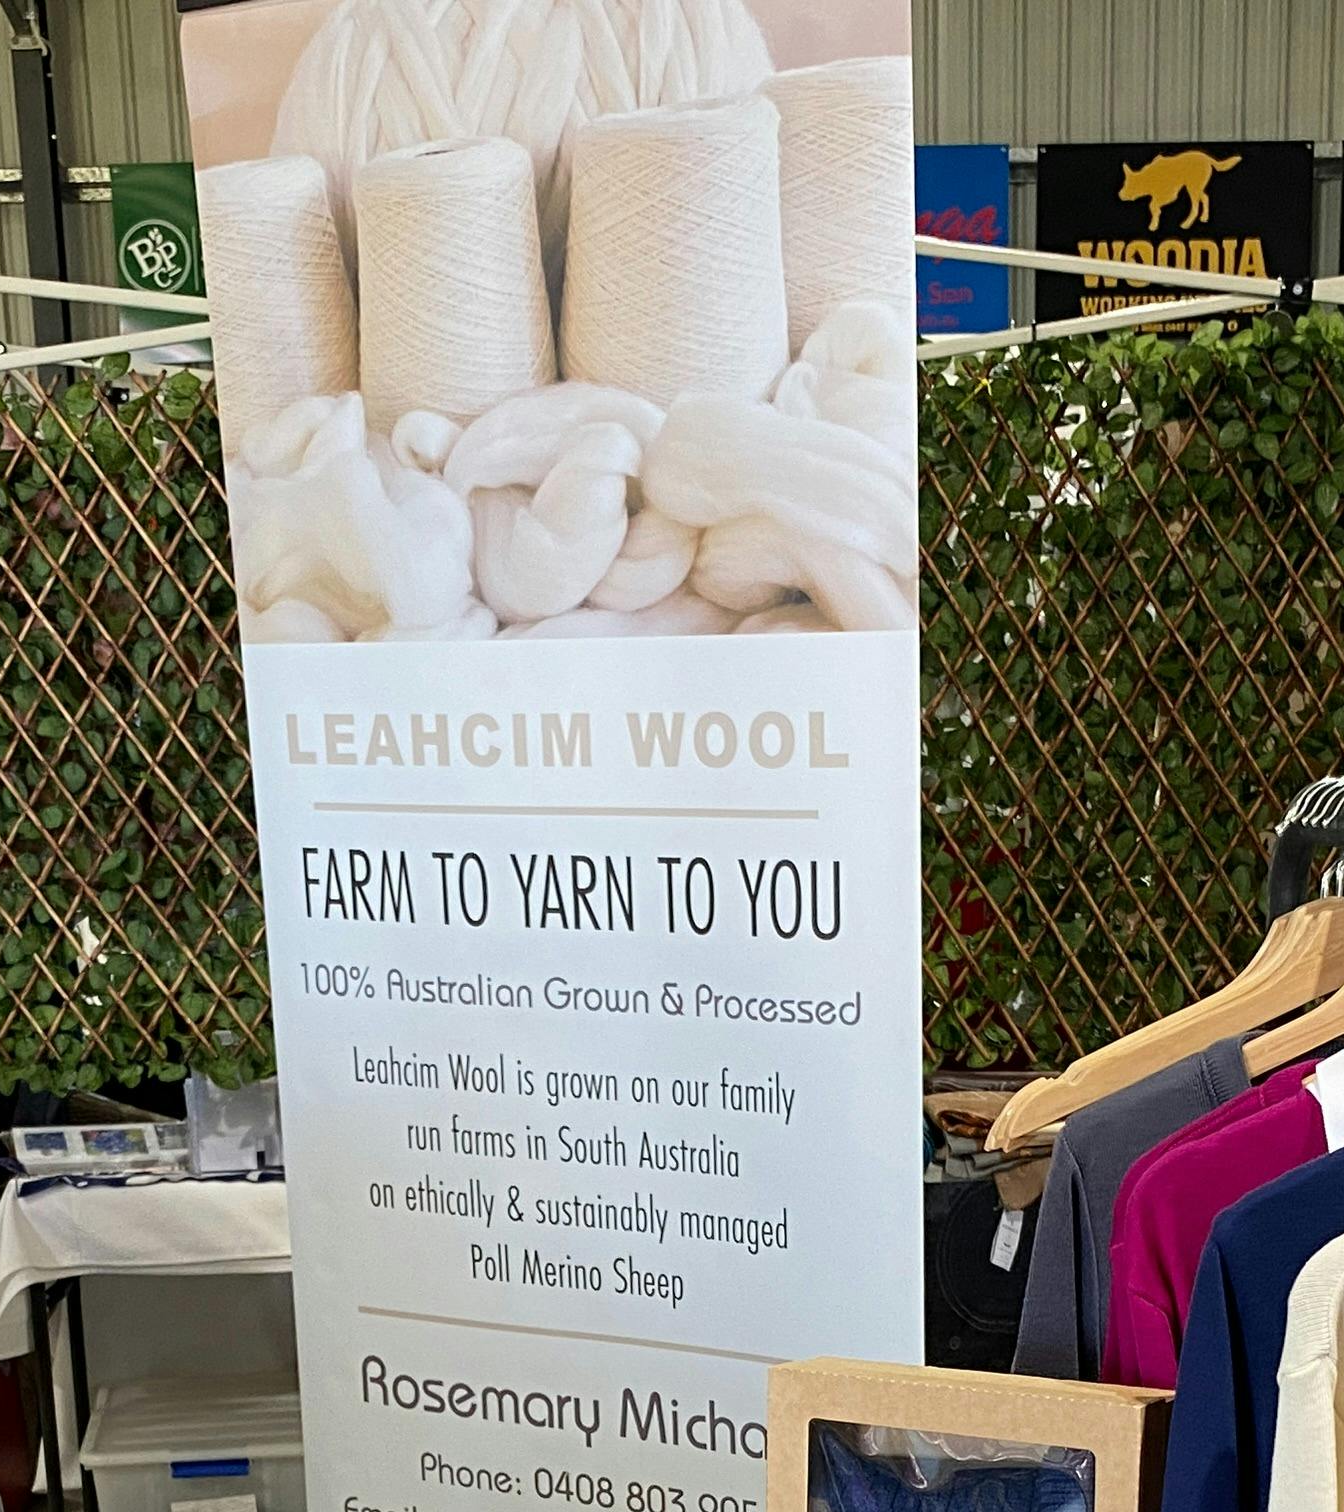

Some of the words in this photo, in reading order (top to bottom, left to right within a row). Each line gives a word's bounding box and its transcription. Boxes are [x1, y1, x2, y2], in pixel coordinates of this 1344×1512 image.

[286, 713, 592, 767] LEAHCIM
[626, 711, 849, 769] WOOL
[301, 846, 417, 925] FARM
[431, 851, 489, 928] TO
[508, 852, 635, 933] YARN
[656, 856, 716, 936] TO
[737, 858, 841, 941] YOU
[300, 962, 376, 999] 100%
[386, 967, 534, 1009] Australian
[543, 976, 650, 1015] Grown
[660, 981, 686, 1017] &
[695, 983, 862, 1027] Processed
[352, 1044, 440, 1090] Leahcim
[447, 1052, 506, 1095] Wool
[516, 1059, 536, 1097] is
[545, 1071, 619, 1108] grown
[631, 1076, 660, 1105] on
[671, 1079, 710, 1109] our
[719, 1066, 796, 1126] family
[407, 1124, 442, 1153] run
[450, 1113, 517, 1159] farms
[525, 1124, 548, 1161] in
[557, 1124, 627, 1168] South
[638, 1130, 740, 1179] Australia
[369, 1182, 395, 1210] on
[405, 1173, 496, 1229] ethically
[506, 1184, 525, 1223] &
[535, 1191, 669, 1245] sustainably
[679, 1206, 788, 1256] managed
[470, 1242, 511, 1284] Poll
[522, 1248, 603, 1292] Merino
[612, 1254, 684, 1310] Sheep
[361, 1354, 601, 1449] Rosemary
[420, 1450, 522, 1496] Phone:
[533, 1466, 616, 1509] 0408
